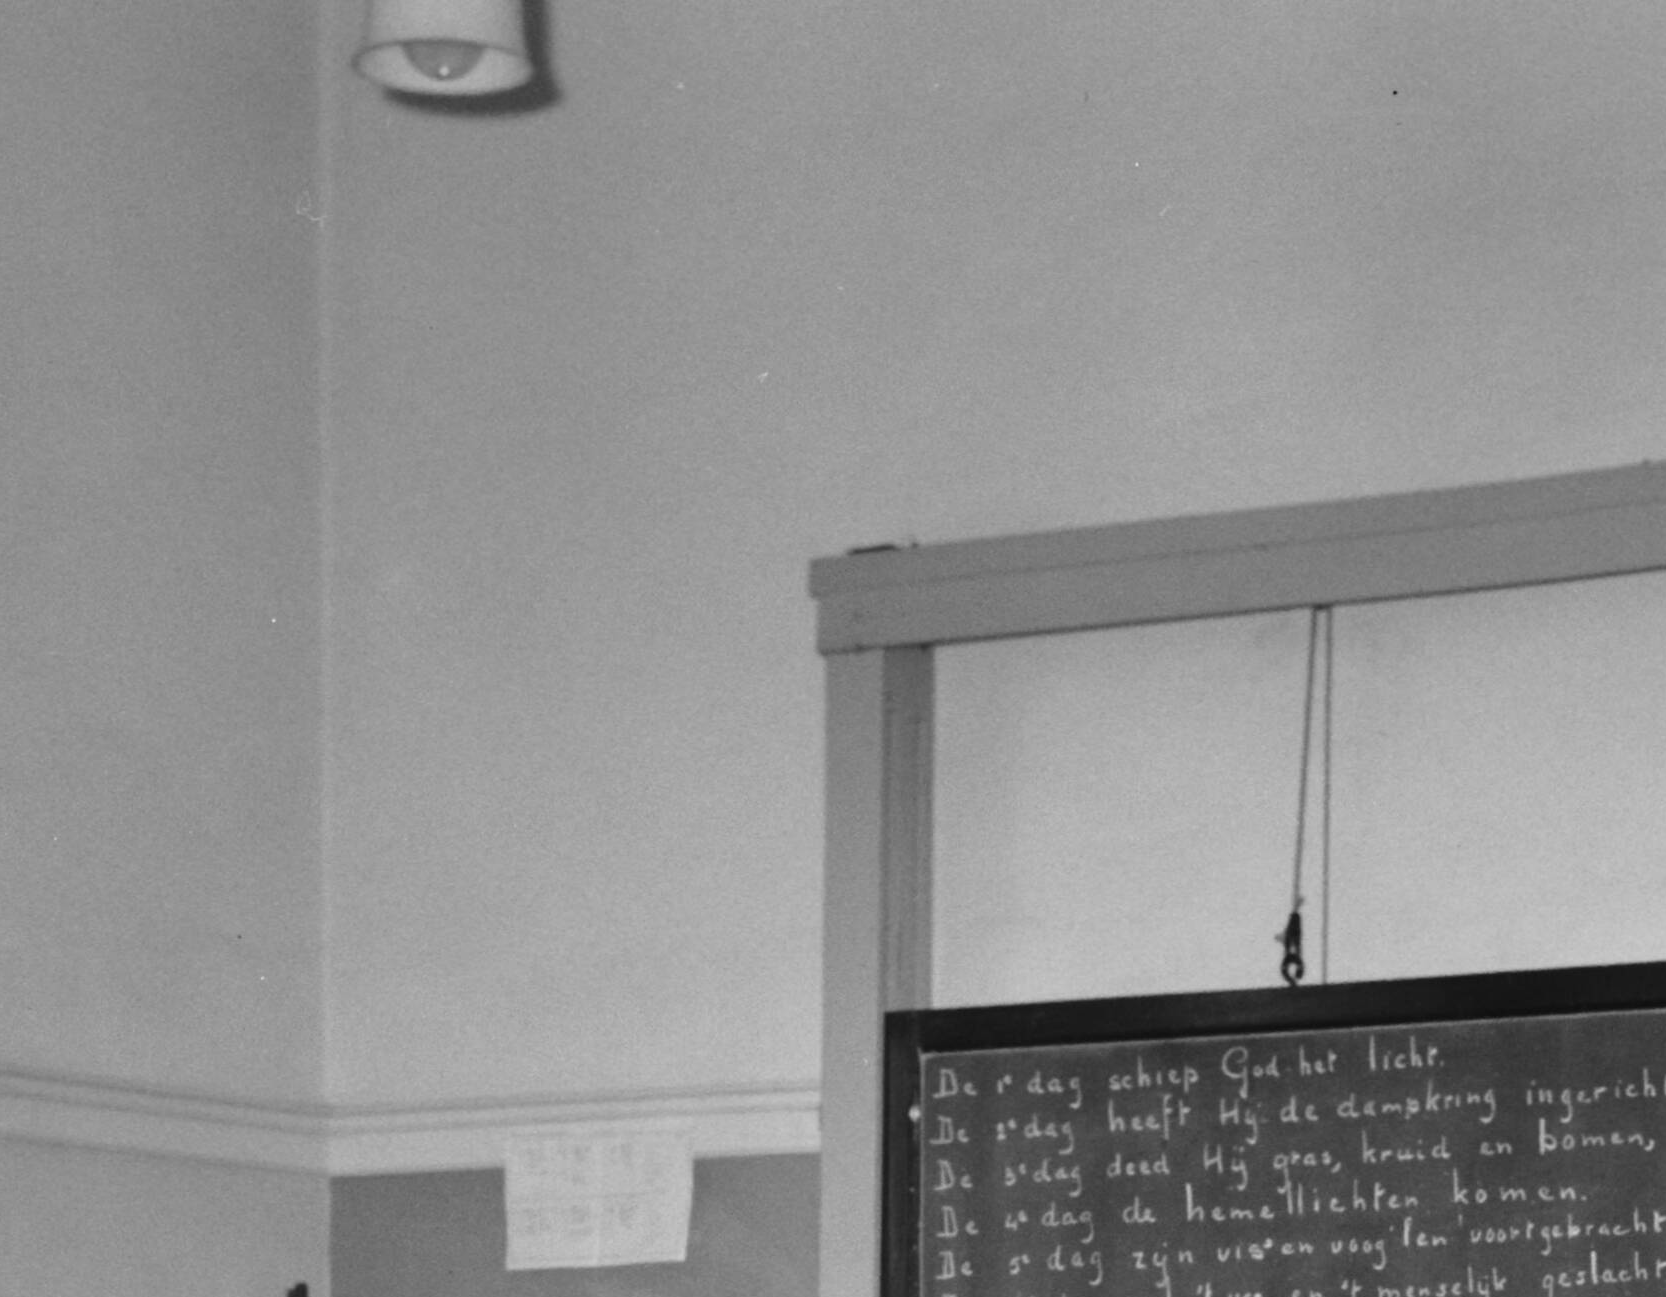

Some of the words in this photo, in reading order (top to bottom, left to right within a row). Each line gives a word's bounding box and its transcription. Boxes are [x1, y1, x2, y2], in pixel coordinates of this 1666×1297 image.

[932, 1068, 978, 1099] De
[1026, 1070, 1082, 1110] dag
[1109, 1056, 1199, 1093] schiep
[1221, 1046, 1280, 1100] God
[1299, 1045, 1337, 1076] het
[1368, 1035, 1444, 1073] licht.
[929, 1115, 970, 1145] De
[1024, 1113, 1075, 1155] dag
[1107, 1093, 1191, 1140] heeft
[1280, 1095, 1319, 1123] de
[933, 1159, 973, 1193] De
[1032, 1158, 1082, 1198] dag
[1106, 1153, 1171, 1178] deed
[1362, 1130, 1451, 1164] kruid
[1479, 1142, 1513, 1156] en
[936, 1205, 979, 1239] De
[1041, 1202, 1094, 1244] dag
[1121, 1196, 1157, 1224] de
[1450, 1168, 1587, 1205] komen.
[935, 1250, 973, 1280] De
[1046, 1245, 1103, 1286] dag
[1280, 1241, 1314, 1255] en
